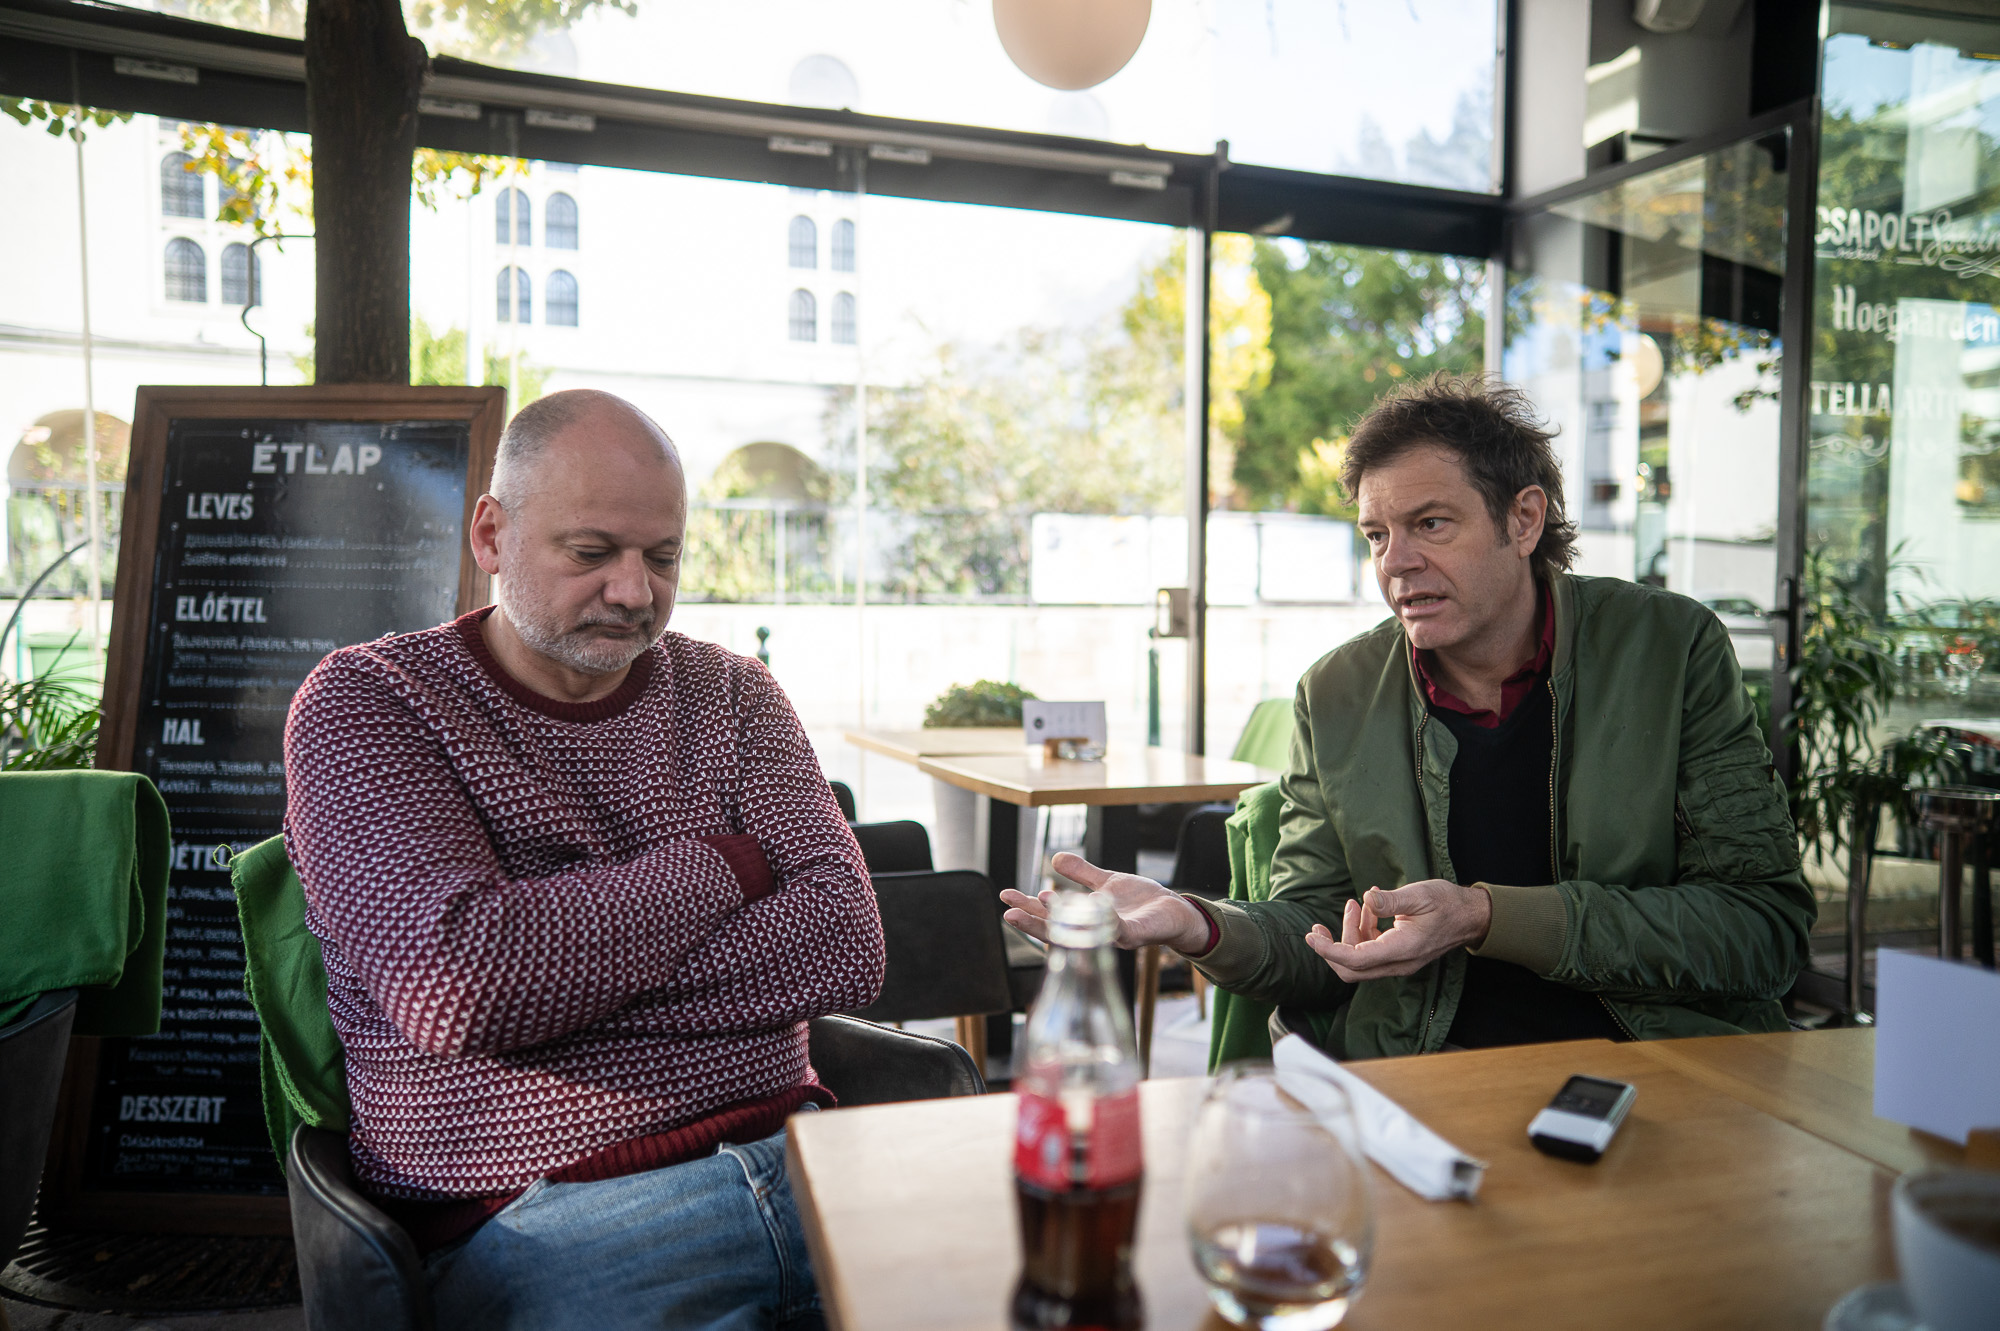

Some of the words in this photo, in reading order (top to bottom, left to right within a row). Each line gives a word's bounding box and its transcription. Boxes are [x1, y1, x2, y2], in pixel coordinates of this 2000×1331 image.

[1831, 283, 1999, 344] Hoegaarden
[1810, 381, 1892, 417] TELLA
[252, 435, 383, 475] ÉTLAP
[186, 492, 255, 521] LEVES
[162, 718, 206, 746] HAL
[119, 1095, 227, 1125] DESSZERT
